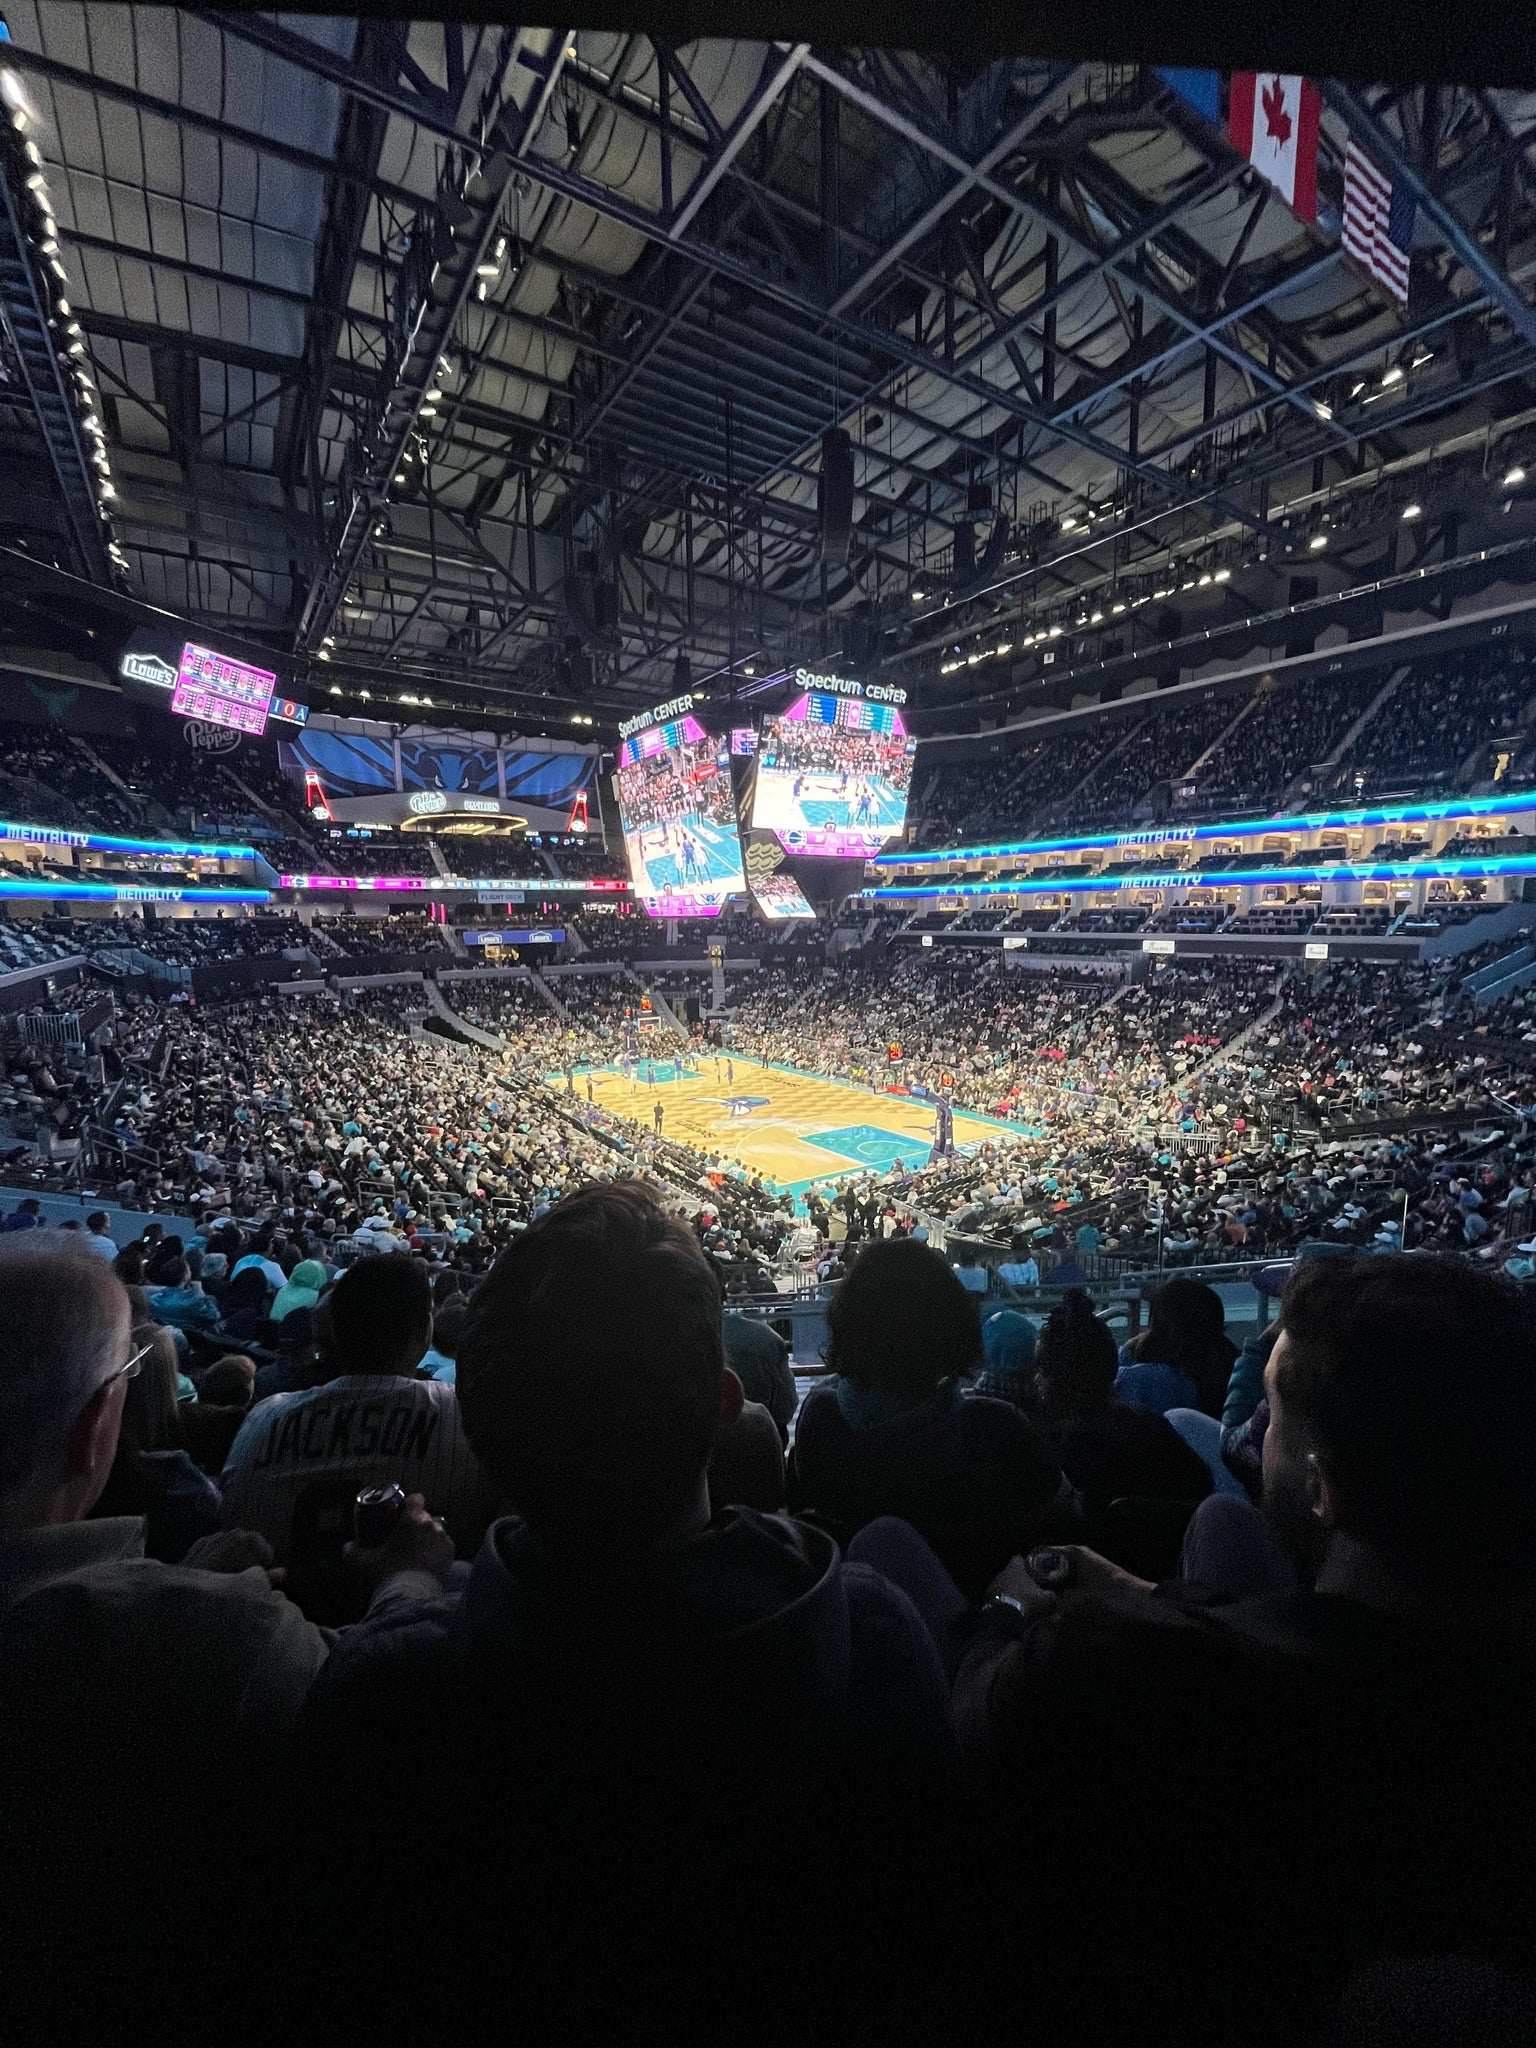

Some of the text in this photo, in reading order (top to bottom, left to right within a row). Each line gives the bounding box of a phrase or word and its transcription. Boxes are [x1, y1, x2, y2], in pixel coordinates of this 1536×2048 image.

[131, 660, 173, 684] LOWE'S
[795, 668, 907, 704] Spectrum CENTER
[618, 694, 693, 739] Spectrum CENTER
[190, 721, 237, 750] Pepper
[6, 826, 89, 847] MENTALITY
[1117, 828, 1197, 846] MENTALITY
[1121, 875, 1203, 889] MENTALITY
[117, 888, 183, 901] MENTALITY
[481, 893, 504, 901] FLIGHT
[255, 1405, 436, 1468] JACKSON
